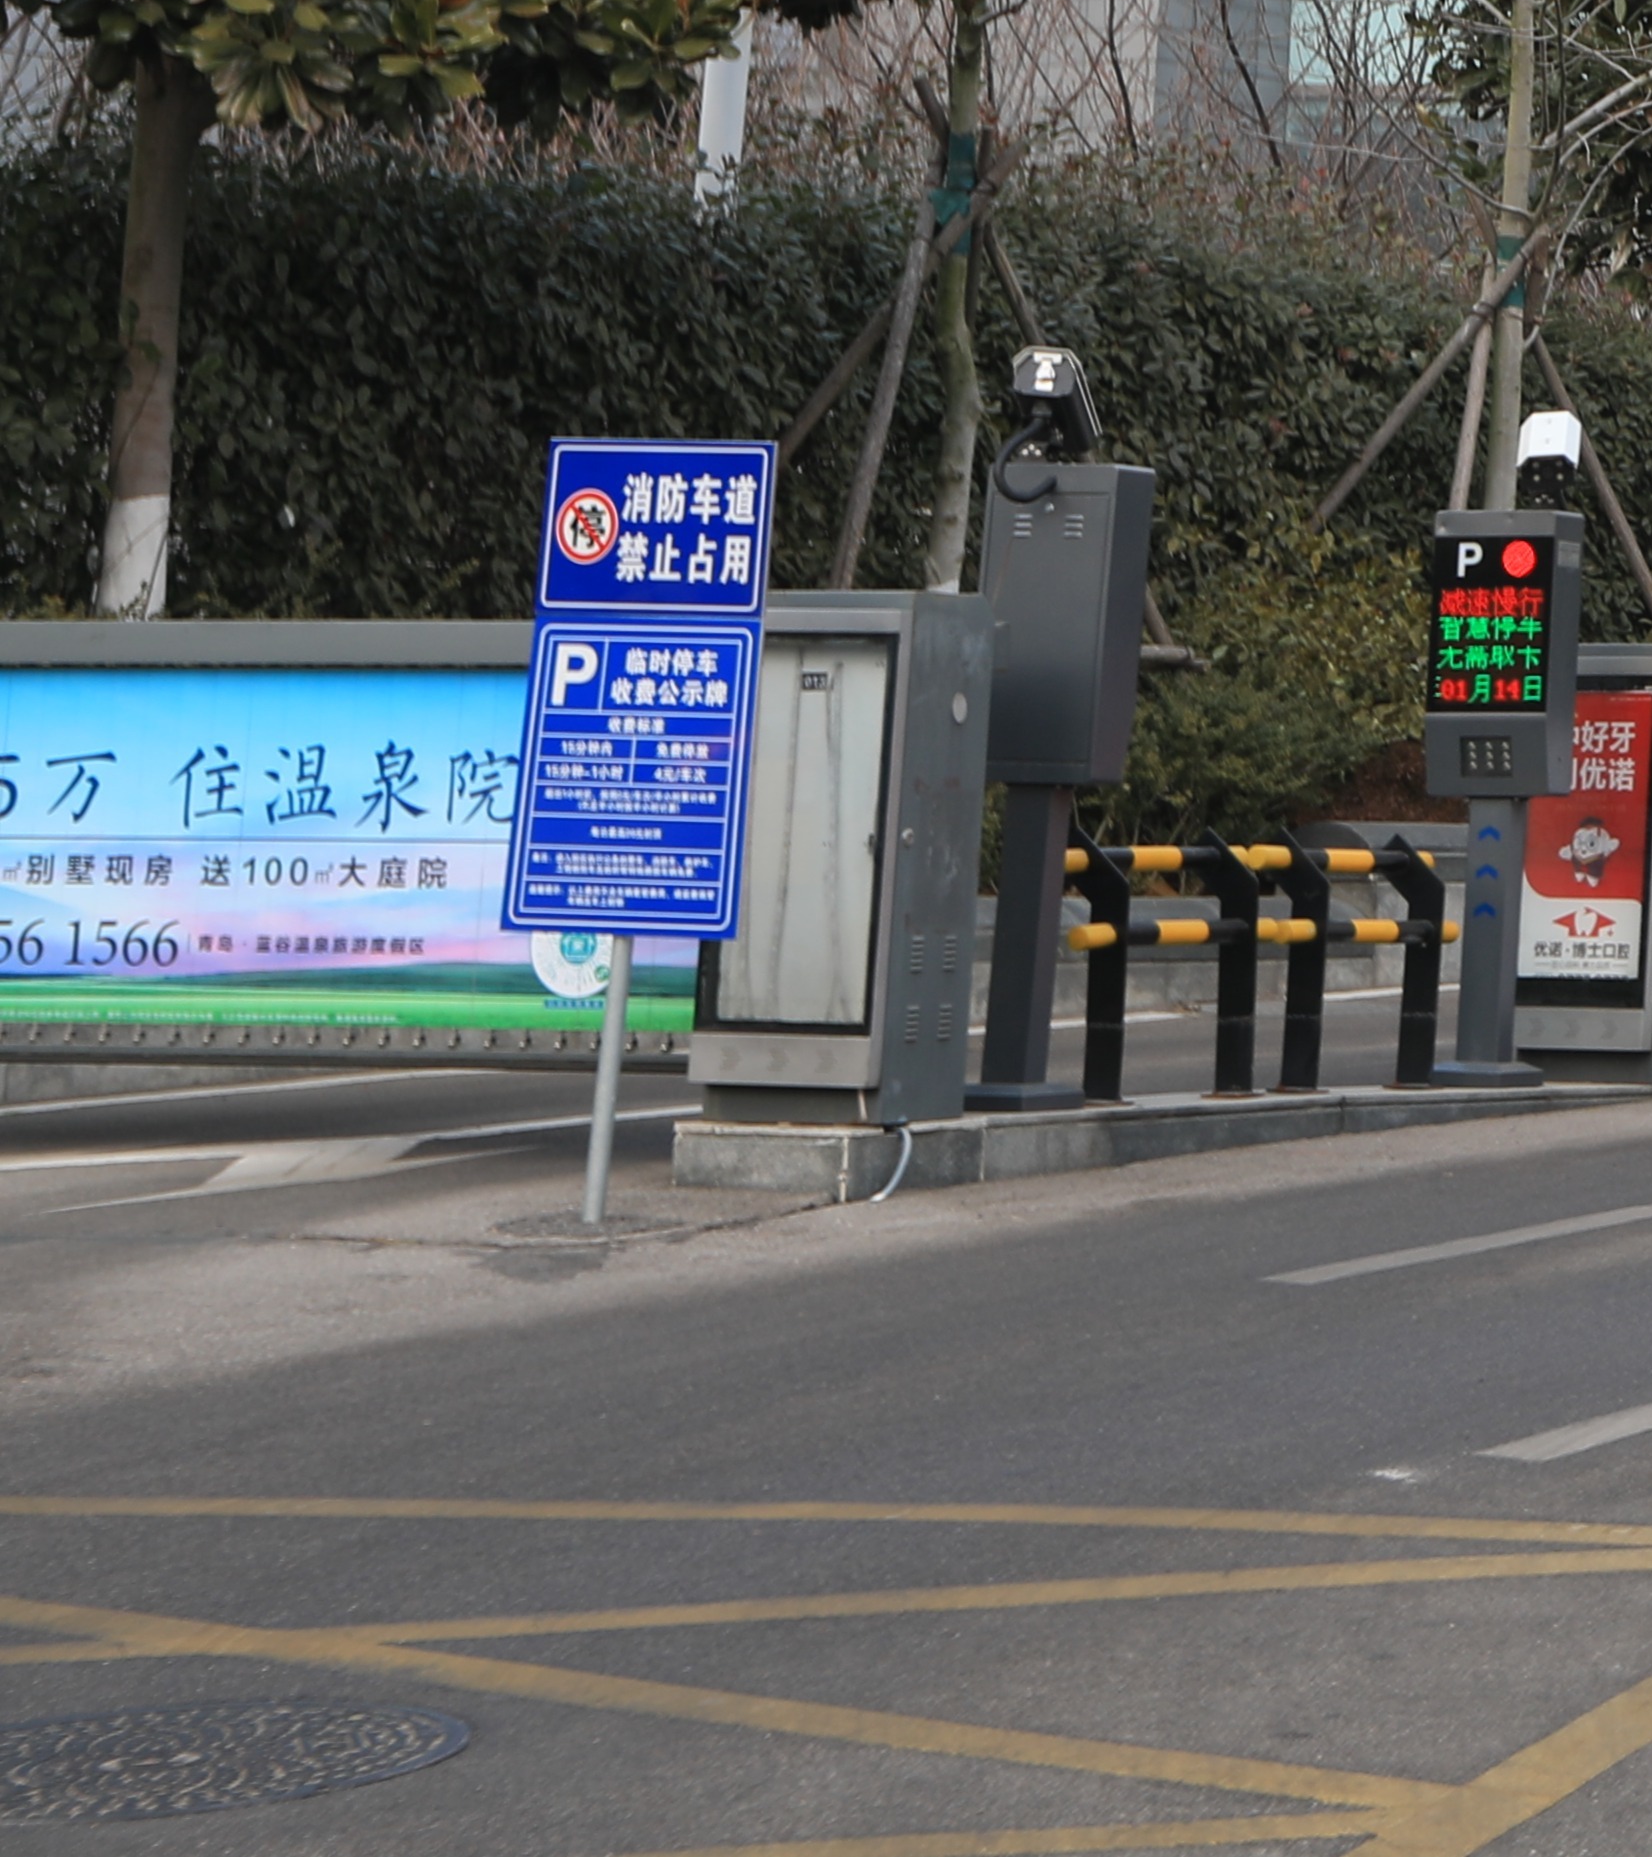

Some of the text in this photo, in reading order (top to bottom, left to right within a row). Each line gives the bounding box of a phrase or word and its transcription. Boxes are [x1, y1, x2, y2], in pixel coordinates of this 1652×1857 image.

[621, 472, 758, 525] 消防车道
[615, 531, 751, 585] 禁止占用
[1457, 542, 1483, 578] P
[1440, 587, 1544, 616] 减速慢行
[551, 644, 598, 707] P
[625, 647, 719, 678] 临时停车
[610, 677, 729, 707] 收费公示牌
[608, 716, 666, 735] 收费标准
[64, 919, 179, 967] 1566
